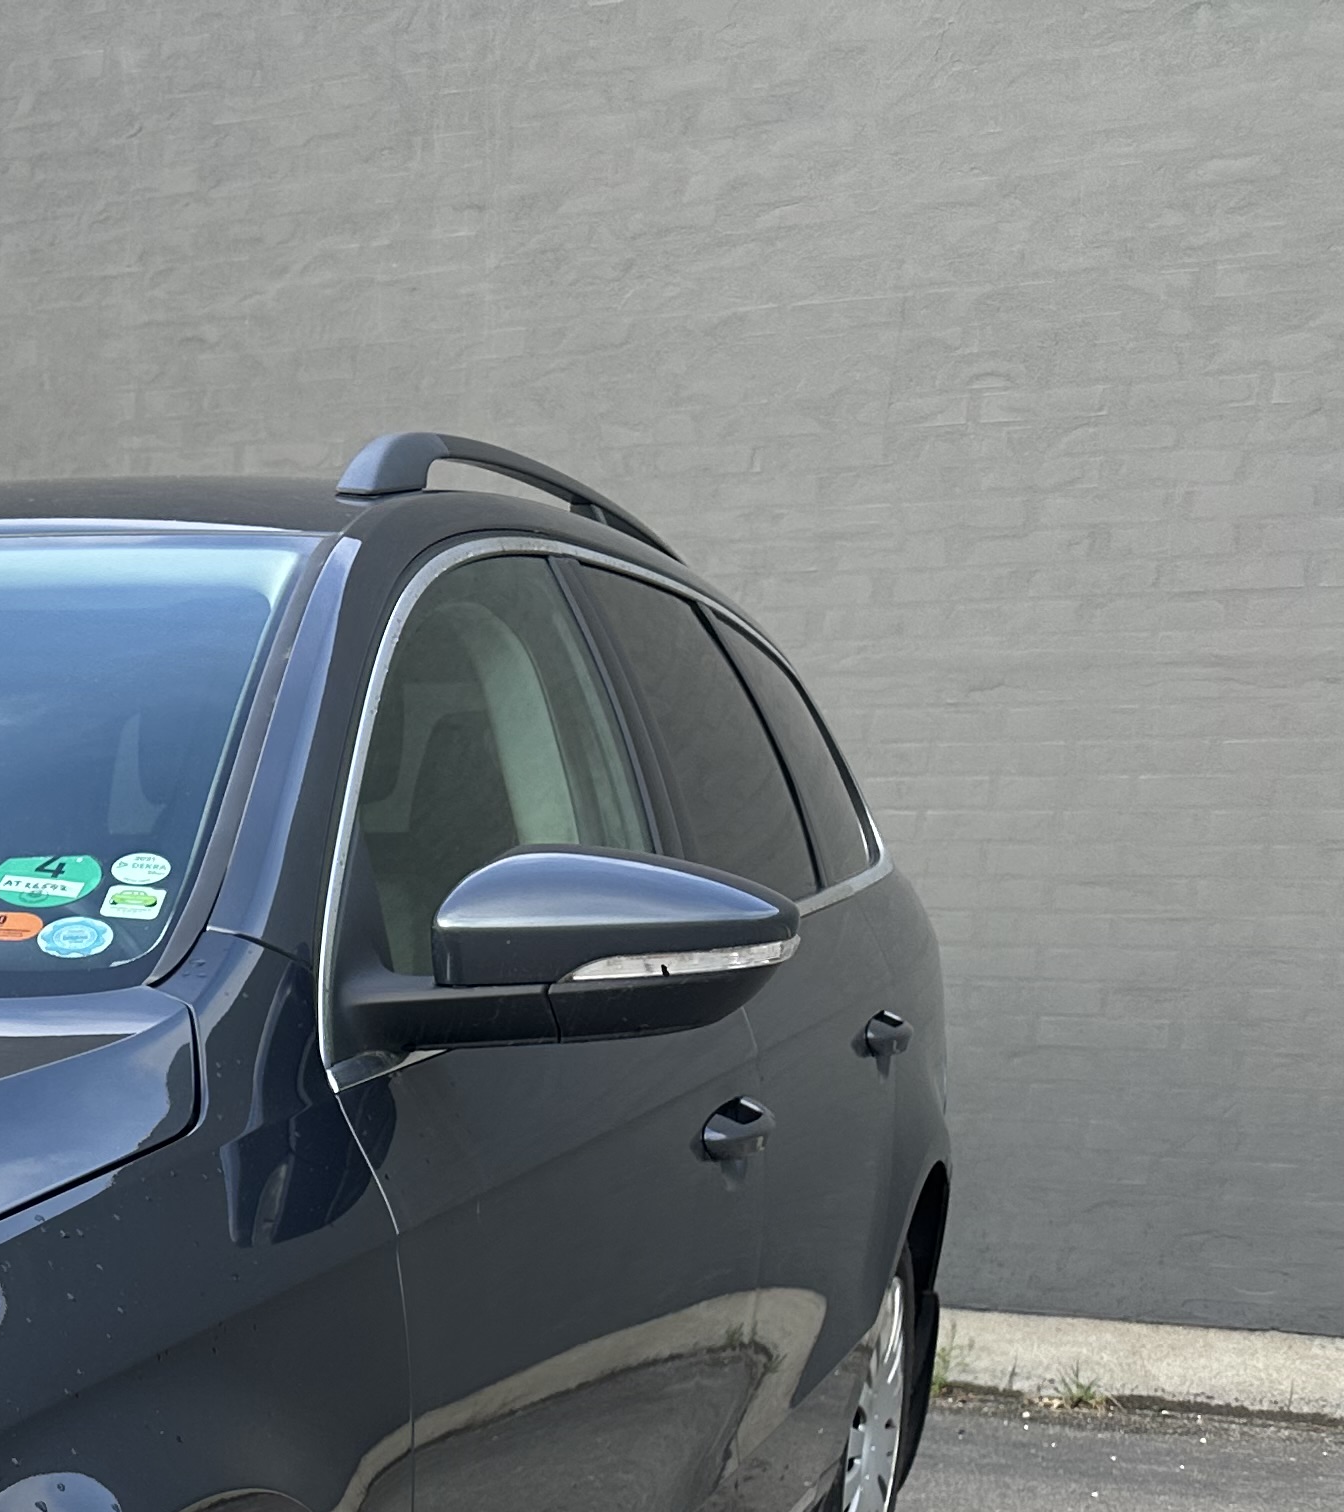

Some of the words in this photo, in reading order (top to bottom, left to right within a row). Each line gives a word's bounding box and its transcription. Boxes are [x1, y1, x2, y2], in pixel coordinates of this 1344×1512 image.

[35, 855, 66, 878] 4
[132, 862, 167, 871] DEKRA
[3, 879, 22, 887] AT
